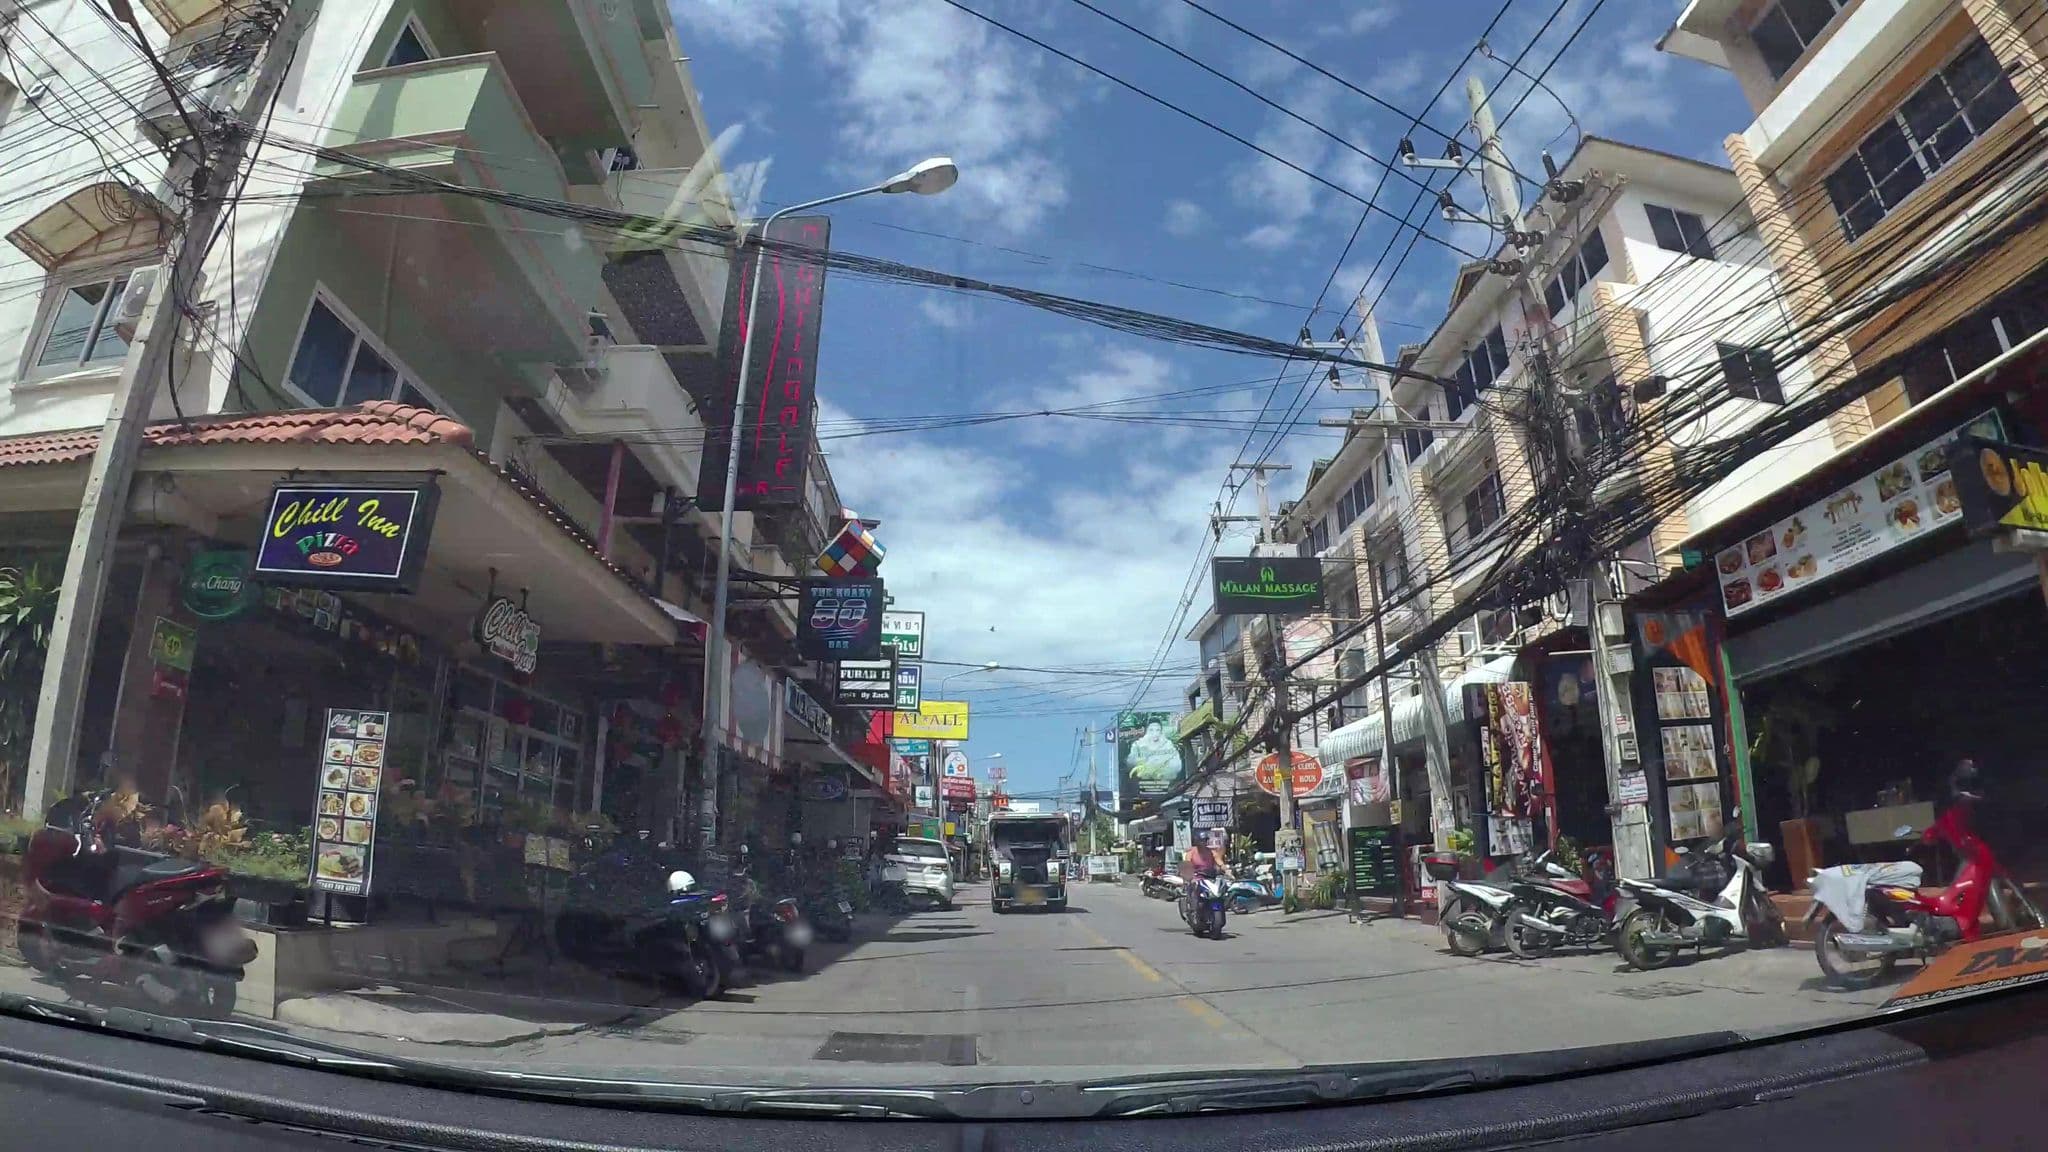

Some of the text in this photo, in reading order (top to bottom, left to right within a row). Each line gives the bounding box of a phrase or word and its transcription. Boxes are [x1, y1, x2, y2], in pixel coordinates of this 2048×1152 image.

[274, 497, 400, 538] Chill Inn
[207, 575, 242, 593] Chang
[1265, 582, 1318, 593] MASSAGE
[810, 587, 833, 596] THE
[929, 714, 962, 726] ALL
